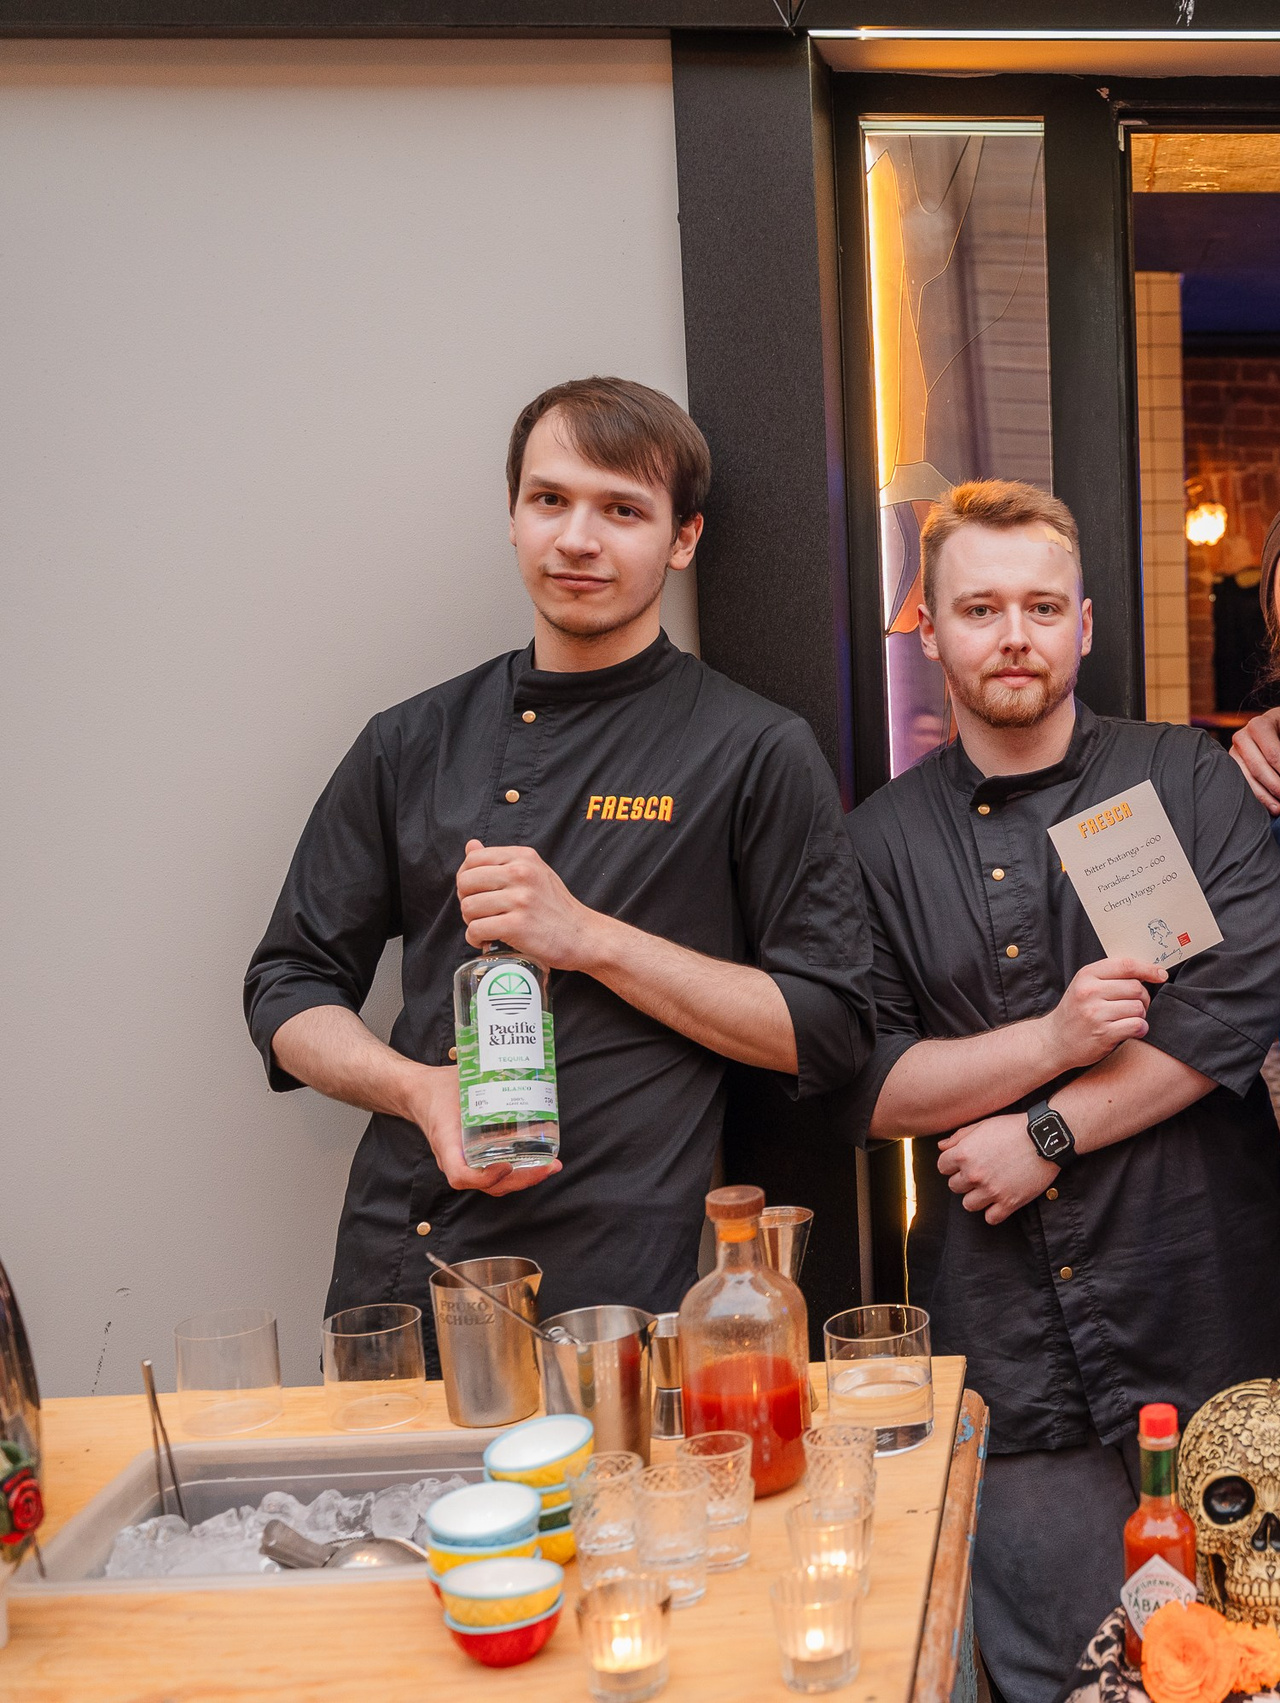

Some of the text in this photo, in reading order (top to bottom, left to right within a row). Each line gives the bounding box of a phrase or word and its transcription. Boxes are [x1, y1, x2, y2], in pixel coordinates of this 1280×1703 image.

[586, 795, 674, 822] FRESCA
[1077, 801, 1133, 839] FRESCA
[1084, 862, 1107, 877] Bitter
[1106, 846, 1140, 866] Batanga
[1145, 834, 1162, 847] 600
[1097, 873, 1131, 893] Paradise
[1130, 866, 1144, 877] 2.0
[1149, 855, 1166, 868] 600
[1103, 896, 1132, 913] Cherry
[1130, 884, 1156, 900] Margo
[1161, 871, 1178, 885] 600
[489, 1021, 536, 1035] Pacific
[1127, 1592, 1192, 1613] TABAO
